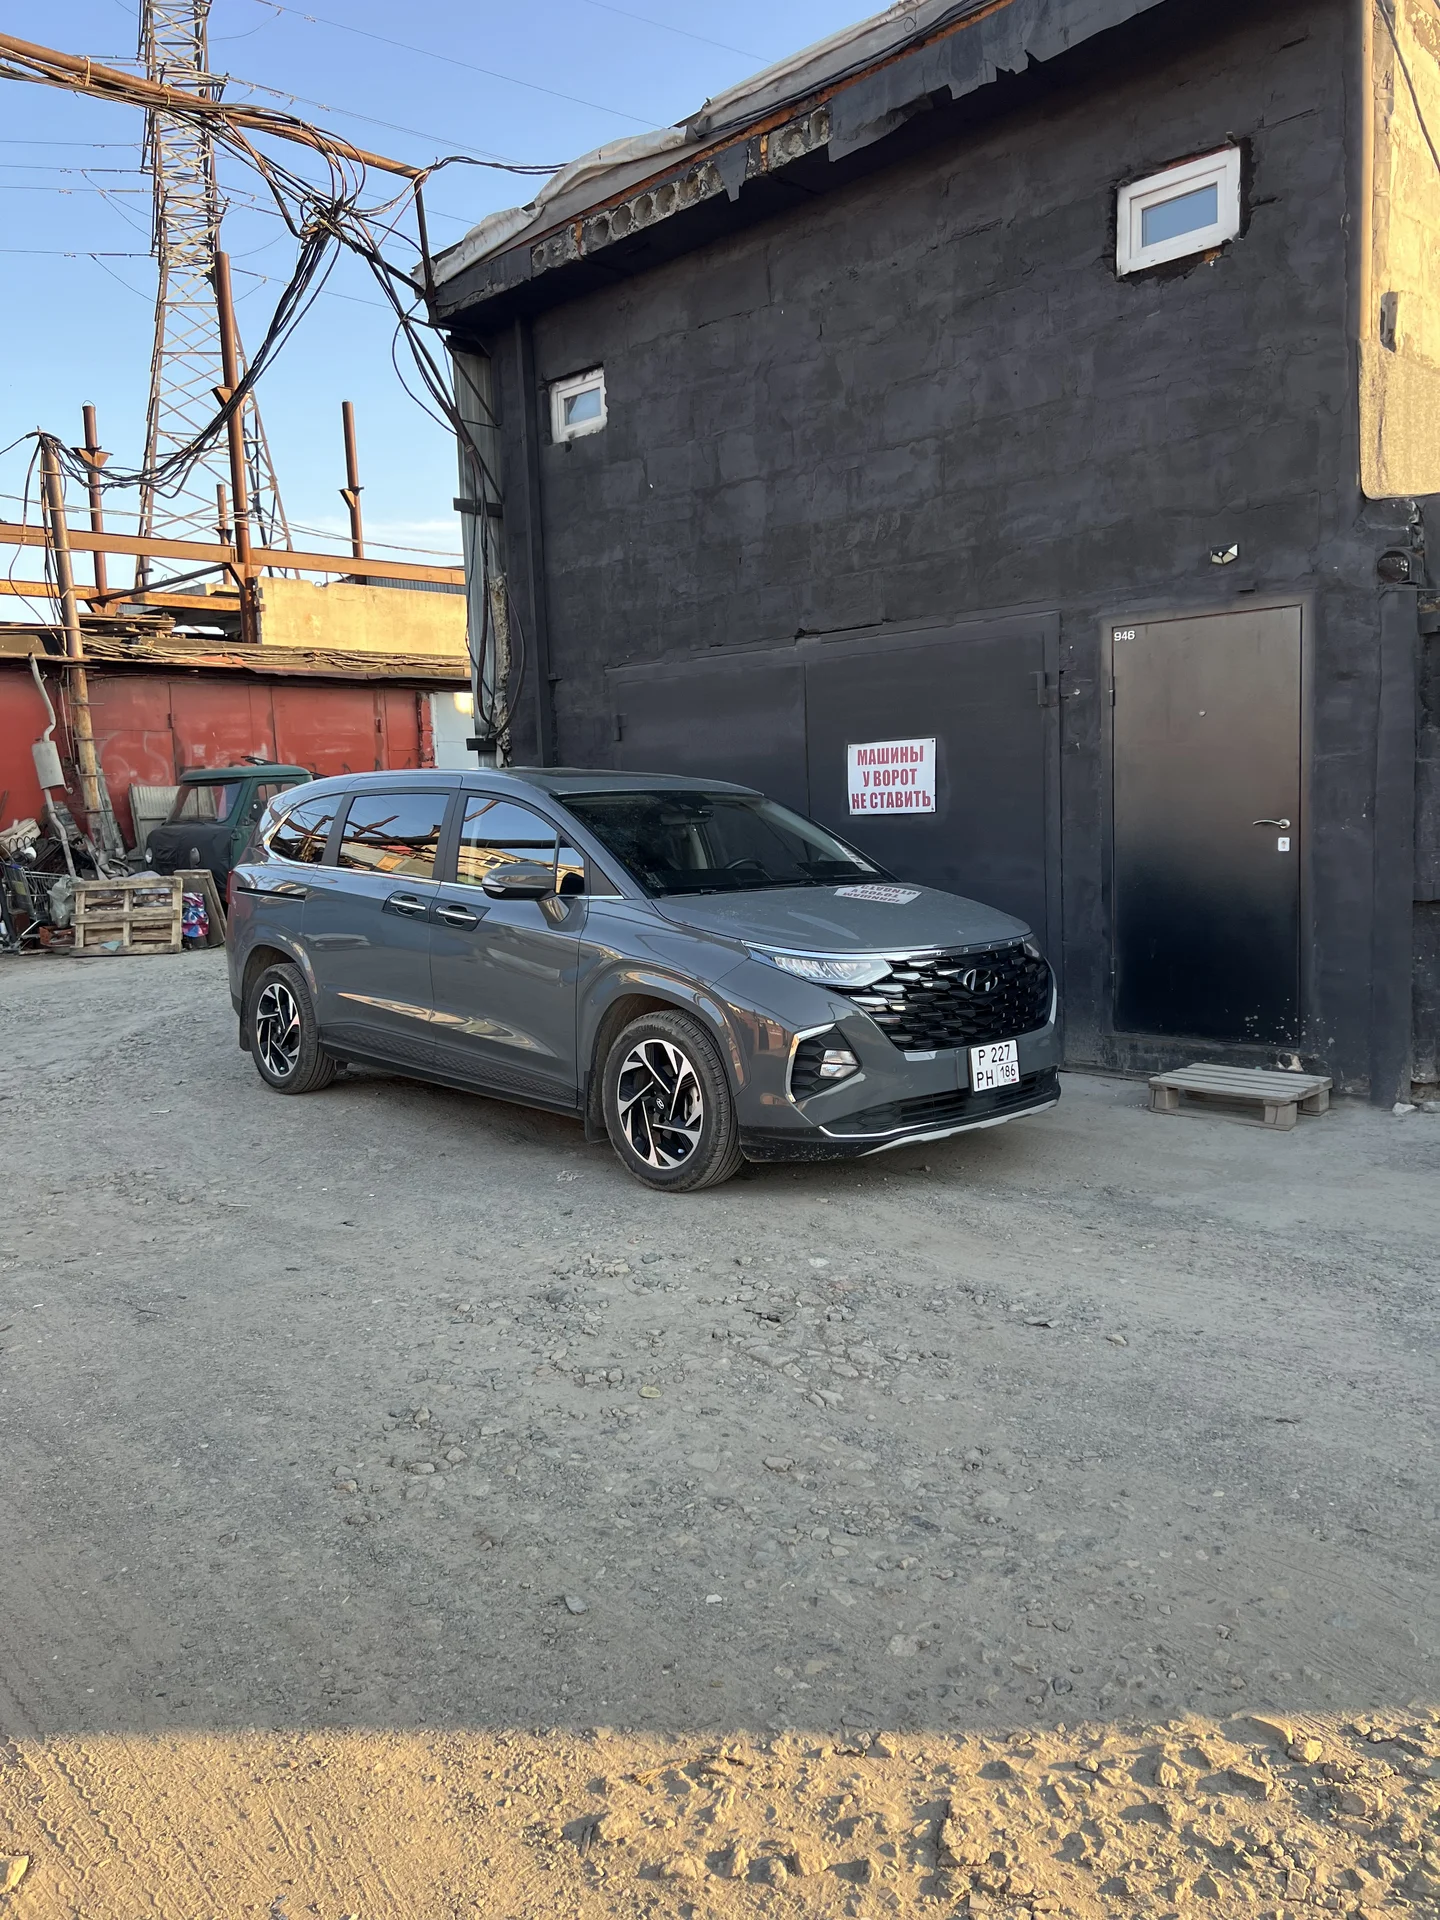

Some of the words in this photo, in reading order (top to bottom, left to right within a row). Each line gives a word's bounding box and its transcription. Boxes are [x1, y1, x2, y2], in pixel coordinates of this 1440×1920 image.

[1114, 630, 1135, 641] 946
[857, 745, 924, 766] МАШИНЫ
[863, 771, 870, 787] У
[873, 768, 917, 787] ВОРОТ
[851, 793, 867, 809] НЕ
[869, 790, 931, 809] СТАВИТЬ
[991, 1044, 1010, 1063] 227
[976, 1069, 994, 1088] РН
[1000, 1064, 1016, 1078] 186
